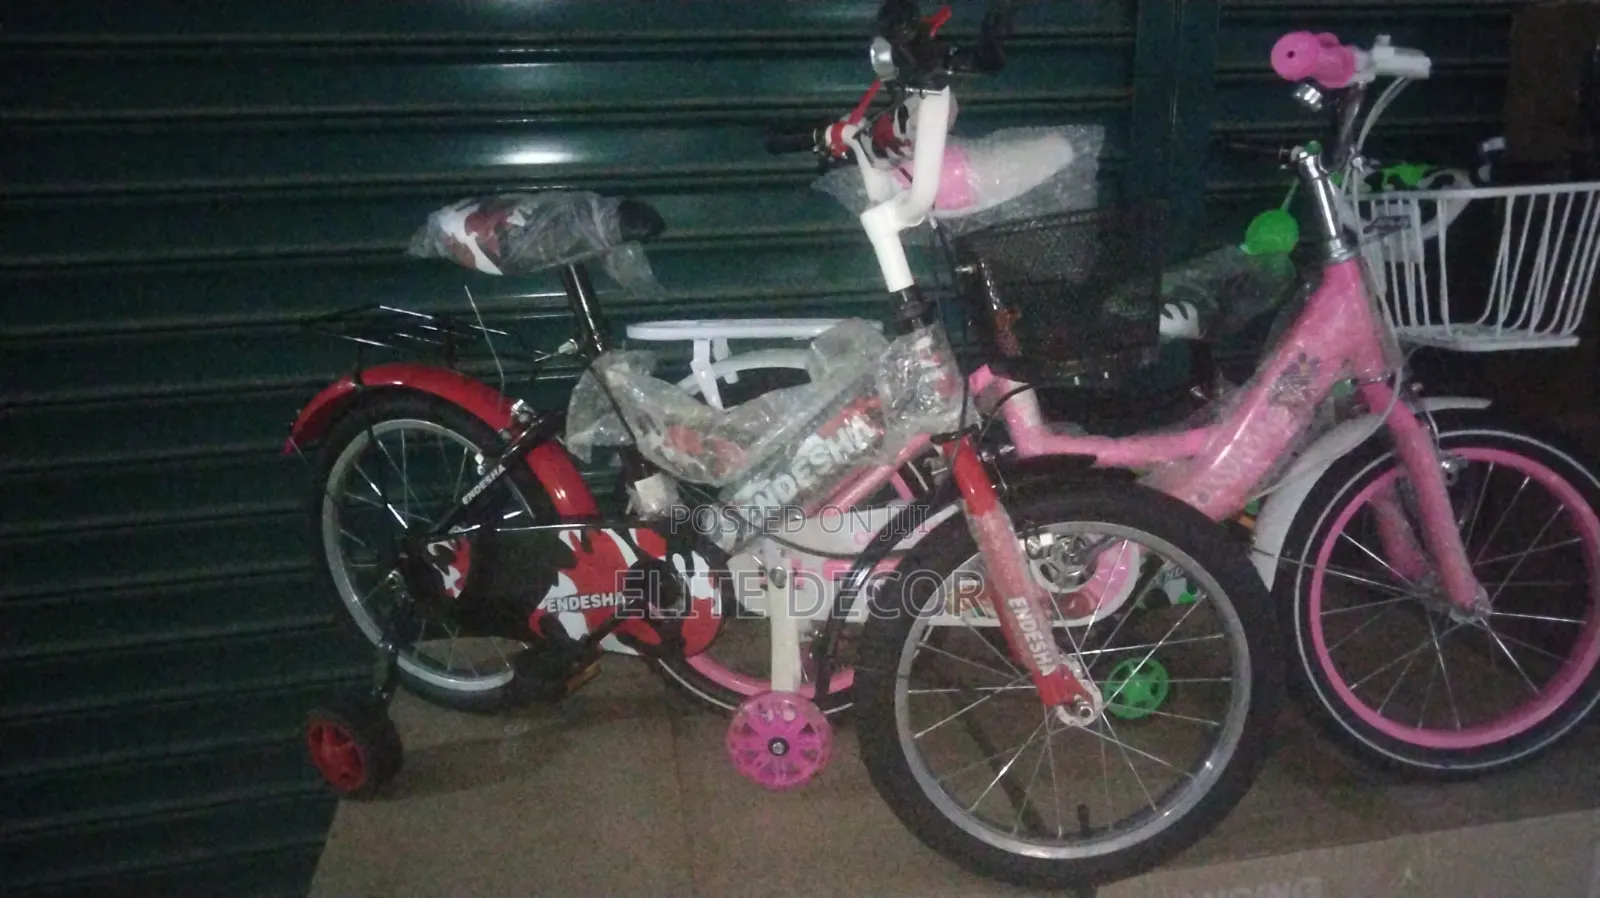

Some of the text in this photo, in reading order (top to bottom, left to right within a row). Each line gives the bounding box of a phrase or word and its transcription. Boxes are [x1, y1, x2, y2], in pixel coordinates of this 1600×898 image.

[461, 464, 506, 505] ENDESHA
[546, 592, 626, 613] ENDESHA
[1007, 596, 1057, 677] ENDESHA
